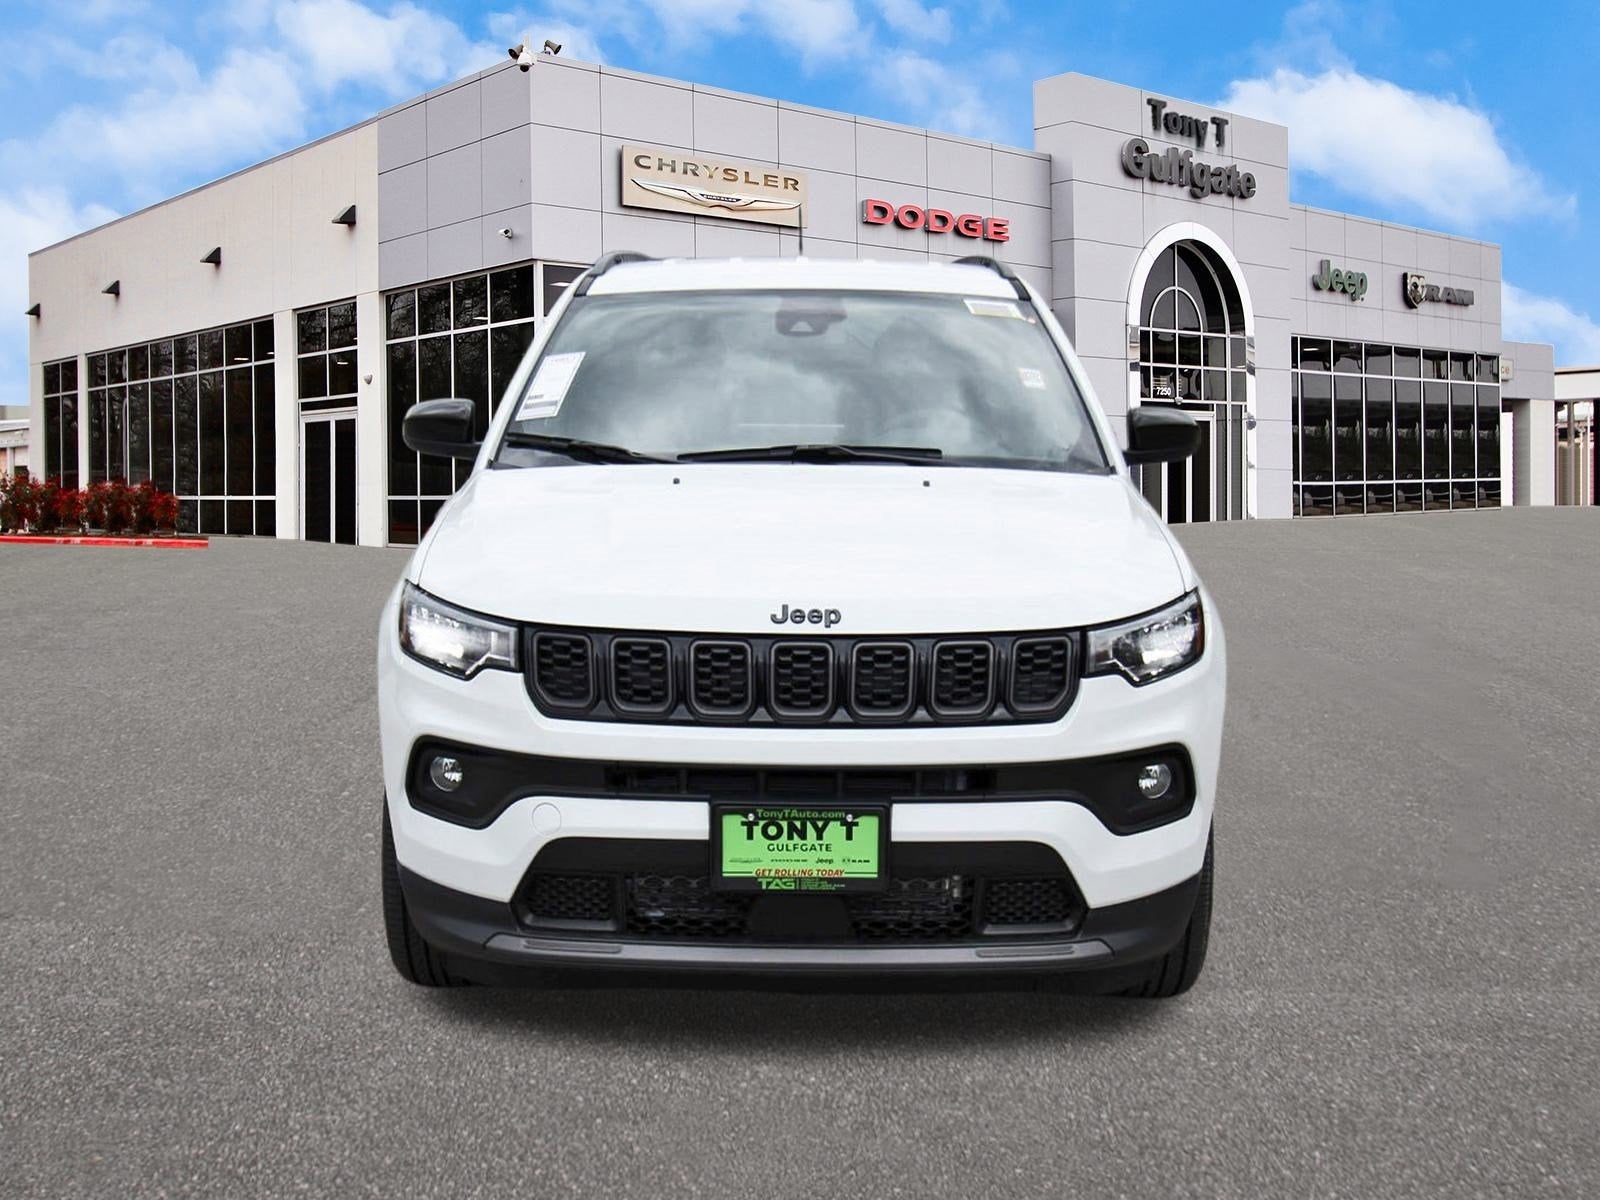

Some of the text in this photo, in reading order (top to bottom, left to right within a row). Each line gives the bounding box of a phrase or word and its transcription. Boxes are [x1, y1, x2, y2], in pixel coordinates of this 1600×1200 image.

[1146, 97, 1229, 148] Tony T
[633, 154, 800, 192] CHRYSLER
[1120, 138, 1256, 199] Gulfgate
[862, 198, 1010, 243] DODGE
[1312, 259, 1368, 302] Jeep
[1424, 284, 1475, 307] RAM
[1156, 386, 1172, 396] 7250
[770, 604, 842, 629] Jeep
[756, 808, 846, 820] TonyTAuto.com
[741, 820, 860, 841] TONY T
[767, 843, 832, 852] GULFGATE
[815, 857, 834, 865] Jeep
[755, 868, 845, 877] GET ROLLING TODAY
[757, 878, 796, 890] TAG
